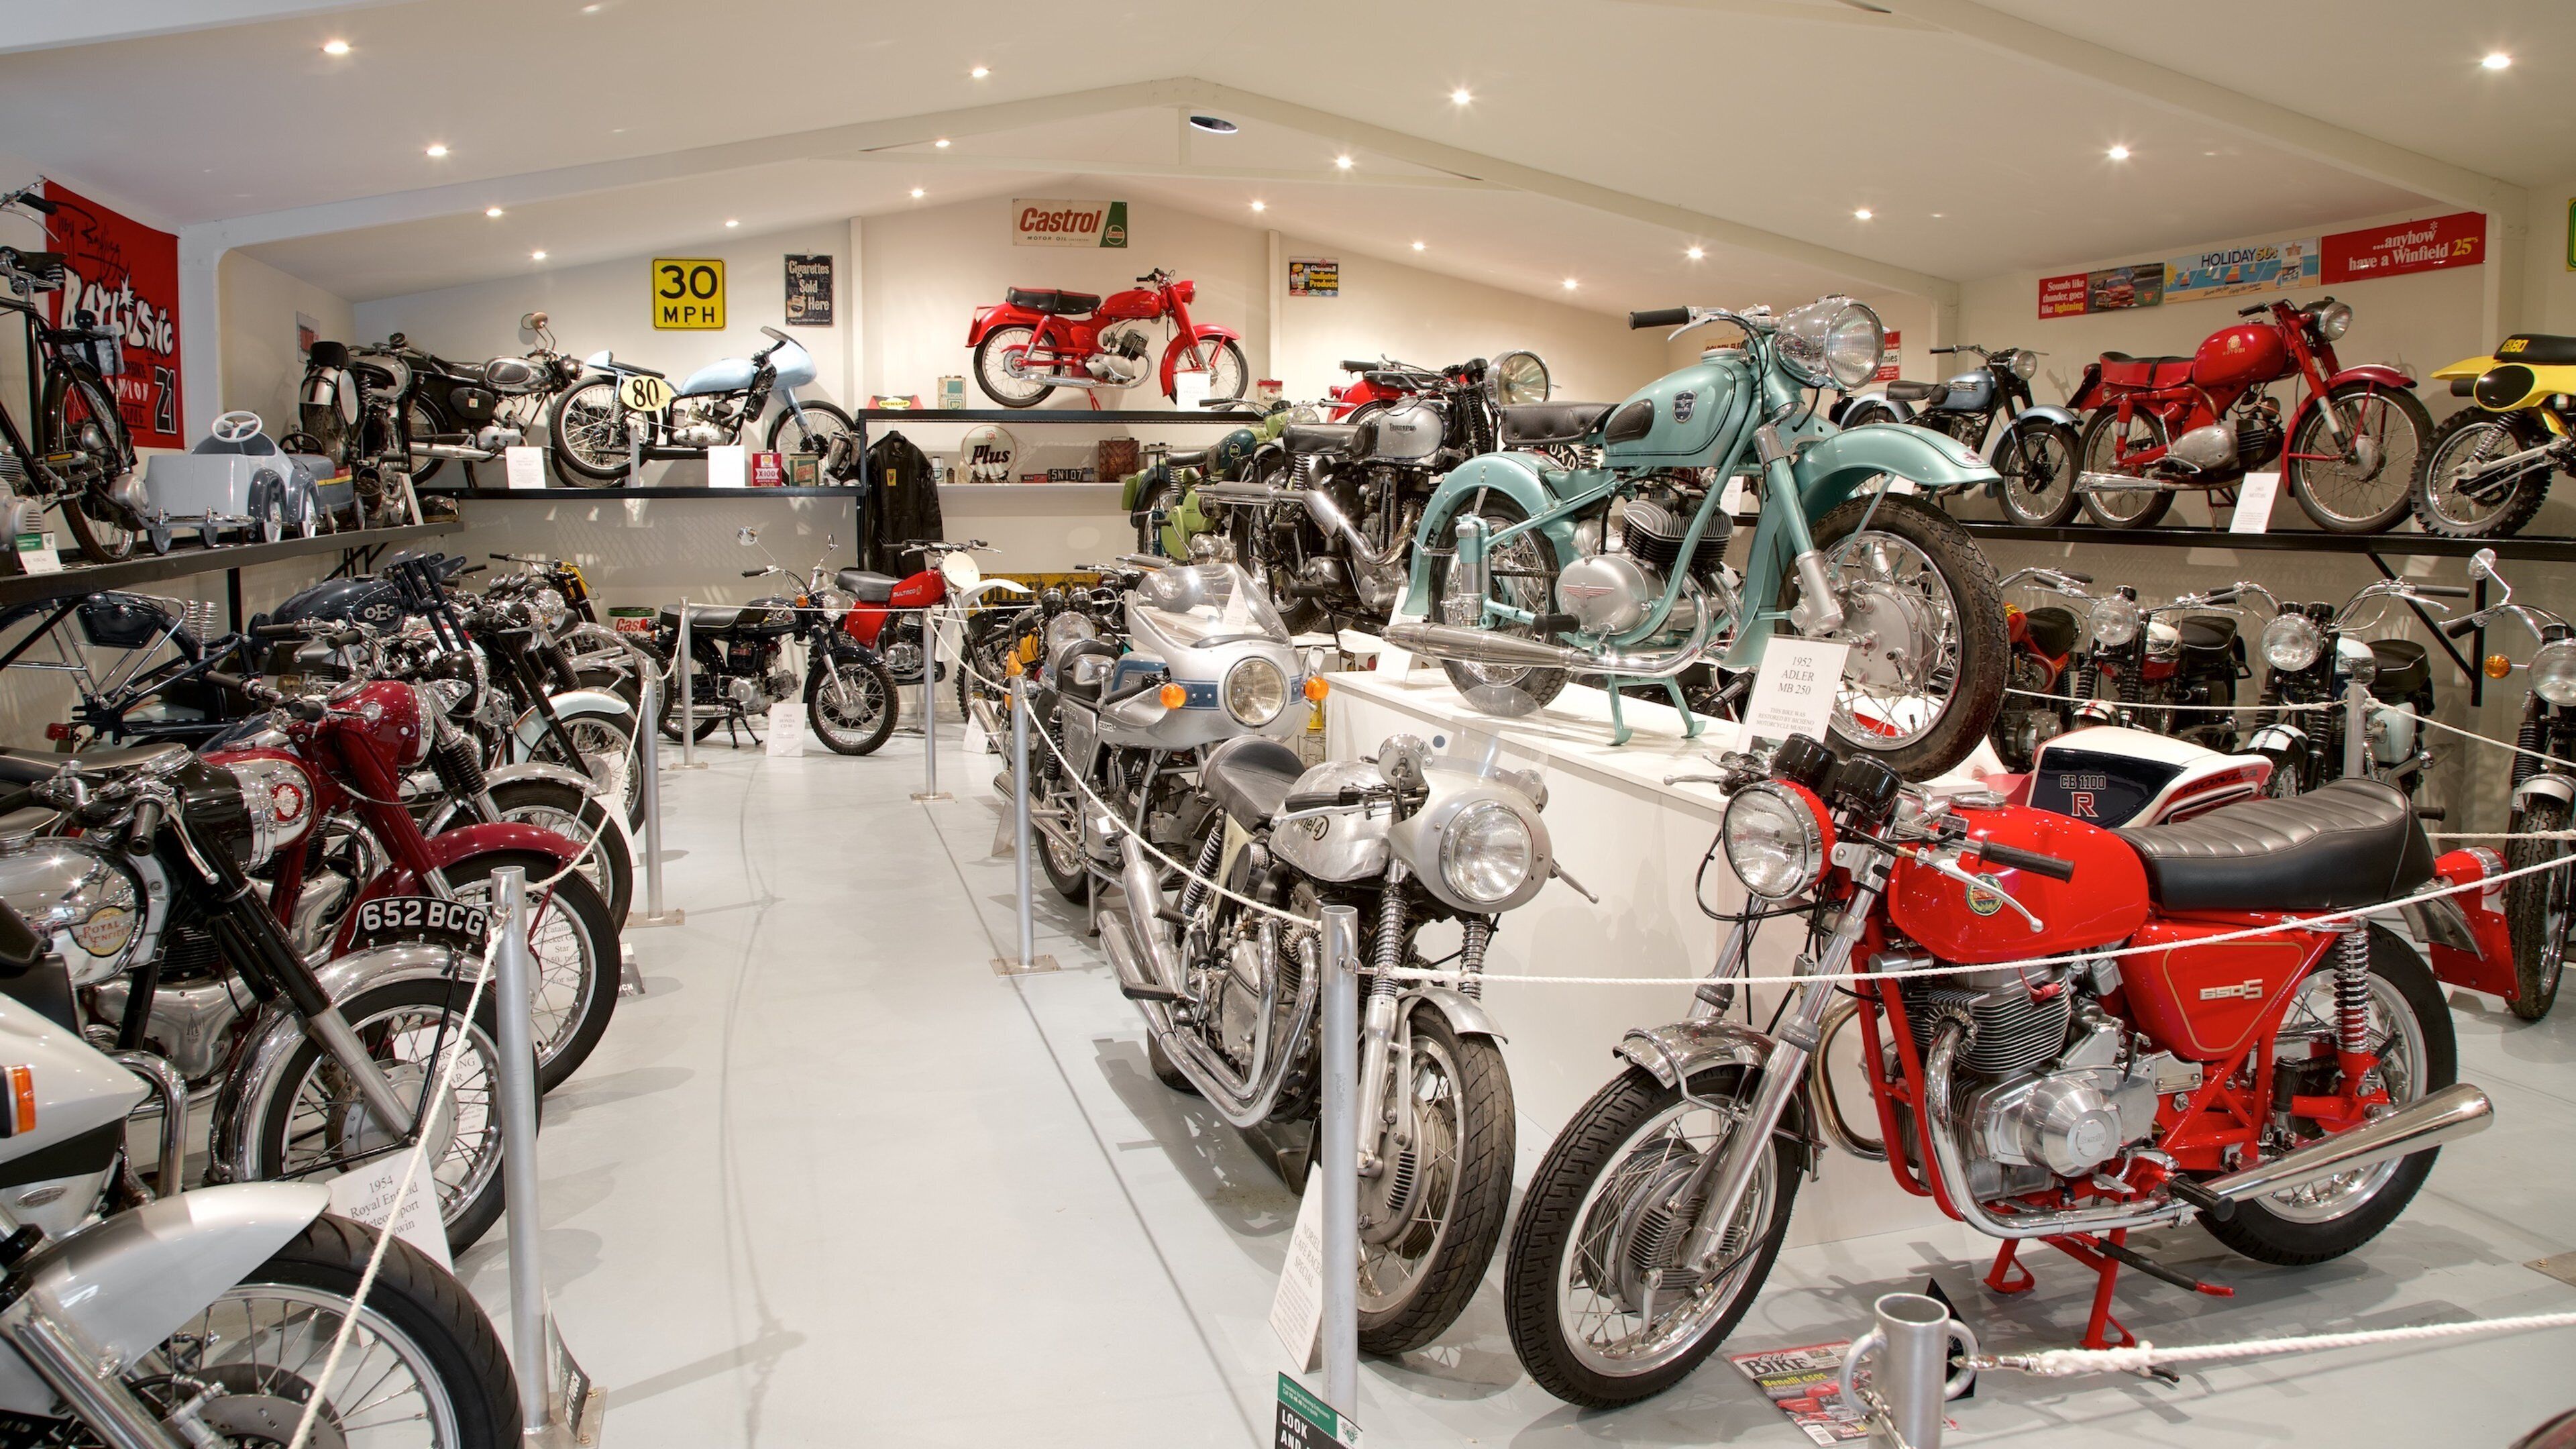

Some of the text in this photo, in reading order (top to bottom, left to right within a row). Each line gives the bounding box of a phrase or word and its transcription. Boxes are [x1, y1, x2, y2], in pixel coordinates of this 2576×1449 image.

[1020, 207, 1102, 233] Castrol
[2202, 249, 2256, 268] HOLIDAY
[2349, 257, 2377, 271] have
[2381, 255, 2389, 266] a
[2392, 242, 2449, 264] Winfield
[788, 260, 830, 278] Cigarettes
[1309, 272, 1338, 280] Radiator
[659, 265, 718, 299] 30
[799, 279, 818, 293] Sold
[1309, 280, 1338, 288] Products
[2047, 279, 2085, 292] Sounds like
[808, 297, 829, 311] Here
[2070, 290, 2084, 302] goes
[664, 307, 714, 323] MPH
[2041, 302, 2084, 315] like lightning
[633, 378, 659, 408] 80
[970, 444, 1011, 465] Plus
[364, 604, 395, 621] OEC
[1792, 656, 1813, 667] 1952
[1782, 669, 1815, 682] ADLER
[1778, 683, 1811, 696] MB 250
[1758, 713, 1784, 722] RESTORED
[1792, 716, 1815, 725] BICHENO
[1782, 708, 1794, 716] BIKE
[1756, 720, 1813, 733] MOTORCYCLE MUSEUM
[2060, 774, 2106, 790] CB 1100
[2183, 769, 2258, 794] HONDA
[2071, 792, 2099, 818] R
[363, 900, 485, 937] 652 BCG
[83, 921, 119, 938] ROYAL
[93, 926, 131, 948] ENFIELD
[555, 945, 570, 953] Star
[369, 1175, 394, 1193] 1954
[350, 1182, 419, 1218] Royal Enfld
[1304, 1223, 1321, 1252] NORIEL
[1294, 1255, 1313, 1288] SPECIAL
[1741, 1357, 1816, 1376] BIKE
[1762, 1376, 1801, 1387] Benelli
[1282, 1409, 1307, 1440] LOOK
[1280, 1430, 1301, 1449] AND
